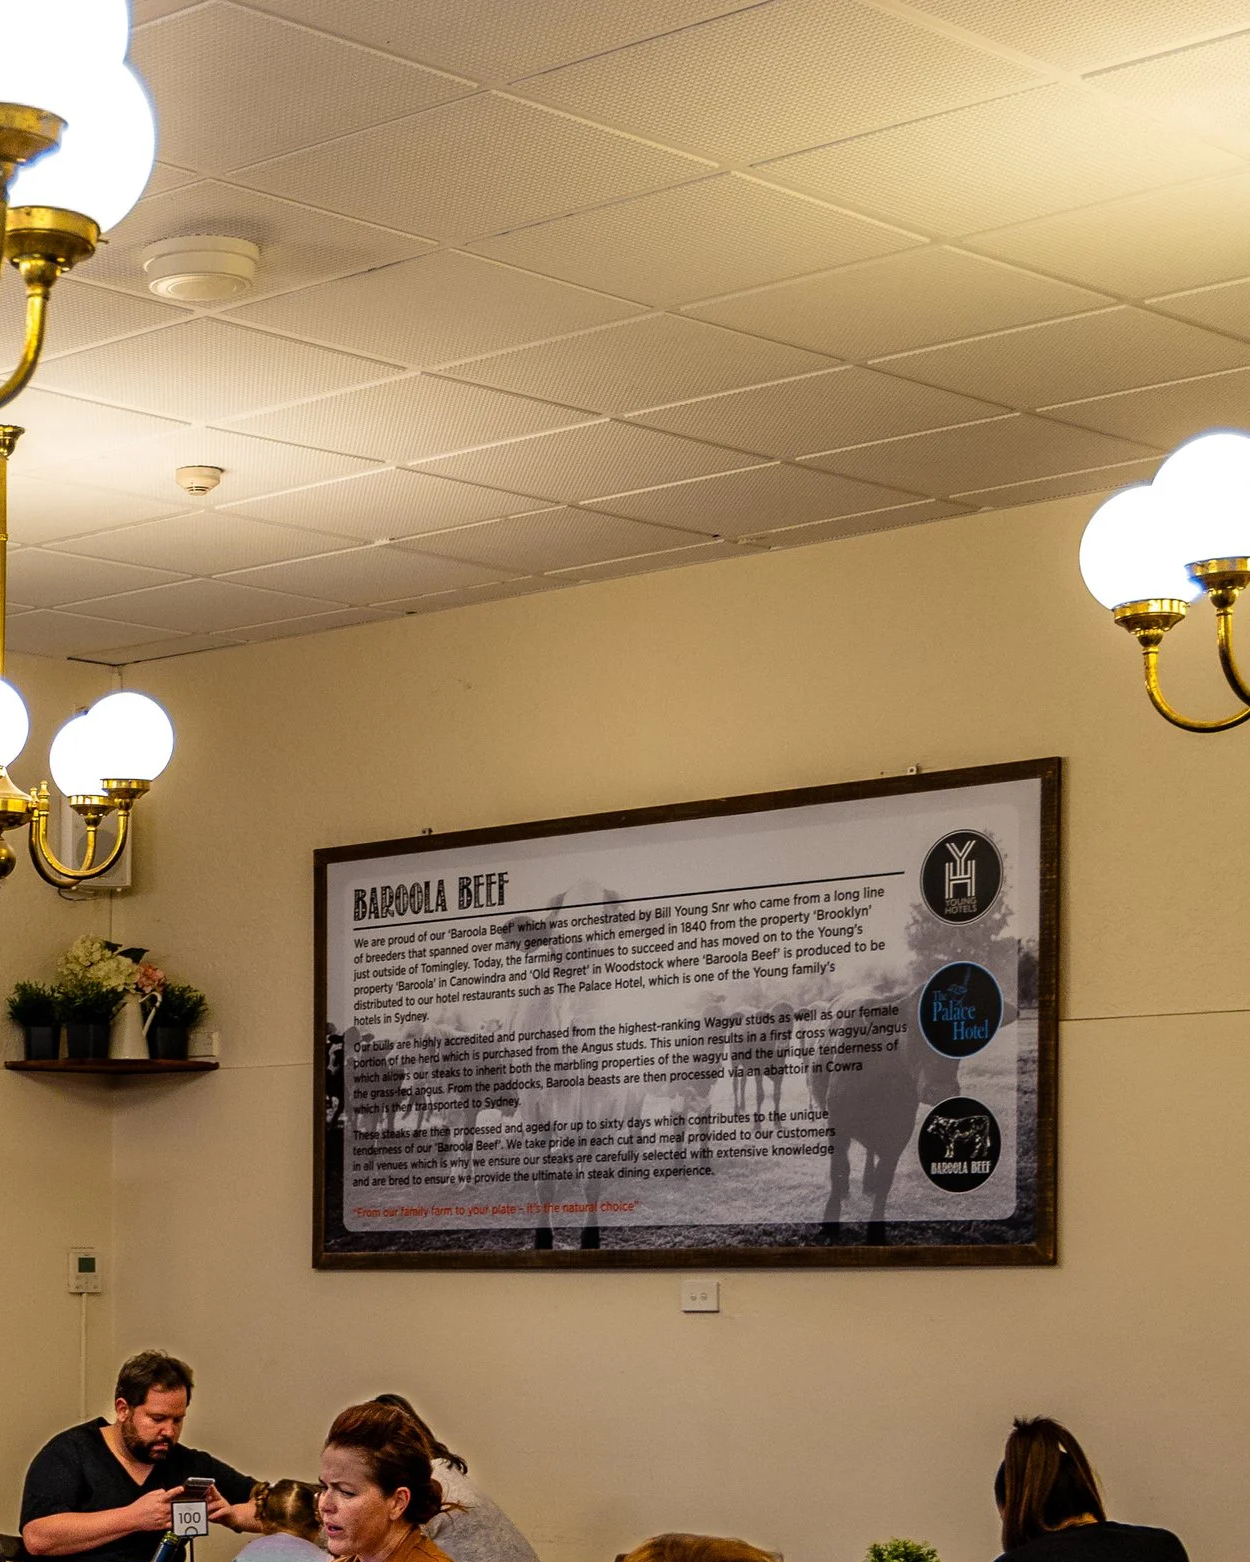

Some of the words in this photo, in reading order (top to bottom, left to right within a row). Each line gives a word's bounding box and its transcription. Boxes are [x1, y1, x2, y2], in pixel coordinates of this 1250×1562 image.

[353, 879, 448, 922] BAROOLA
[458, 871, 509, 910] BEEF
[945, 897, 977, 907] YOUNG
[354, 937, 369, 948] We
[370, 937, 386, 946] are
[387, 931, 415, 947] proud
[417, 930, 427, 942] of
[429, 931, 445, 940] our
[517, 918, 546, 932] which
[549, 919, 568, 929] was
[570, 909, 636, 926] orchestrated
[638, 907, 652, 922] by
[654, 905, 671, 918] Bill
[674, 902, 708, 919] Young
[711, 900, 730, 913] Snr
[732, 897, 757, 911] who
[759, 897, 790, 908] came
[793, 890, 820, 905] from
[823, 892, 831, 902] a
[834, 886, 860, 903] long
[863, 884, 885, 898] line
[945, 905, 977, 914] HOTELS
[353, 952, 363, 963] of
[365, 948, 406, 962] breeders
[408, 946, 427, 958] that
[429, 942, 469, 959] spanned
[471, 942, 492, 952] over
[494, 940, 521, 953] many
[524, 932, 583, 950] generations
[585, 927, 615, 942] which
[618, 923, 665, 941] emerged
[668, 923, 678, 934] in
[680, 920, 707, 933] 1840
[709, 916, 736, 930] from
[739, 914, 757, 927] the
[760, 910, 810, 928] property
[353, 968, 370, 981] just
[372, 963, 406, 977] outside
[408, 962, 418, 974] of
[420, 958, 470, 975] Tomingley.
[473, 954, 503, 971] Today,
[505, 953, 522, 965] the
[524, 949, 563, 966] farming
[565, 945, 615, 960] continues
[617, 944, 629, 955] to
[631, 939, 674, 954] succeed
[677, 936, 697, 950] and
[700, 934, 719, 948] has
[722, 931, 759, 946] moved
[762, 932, 777, 942] on
[780, 929, 793, 941] to
[795, 926, 814, 939] the
[353, 981, 393, 997] property
[438, 977, 447, 987] in
[449, 970, 506, 986] Canowindra
[508, 968, 527, 981] and
[592, 963, 601, 974] in
[604, 956, 664, 973] Woodstock
[666, 953, 699, 968] where
[783, 946, 793, 958] is
[795, 940, 851, 959] produced
[854, 940, 867, 952] to
[870, 937, 885, 950] be
[353, 995, 403, 1010] distributed
[405, 995, 415, 1006] to
[417, 996, 433, 1005] our
[435, 990, 459, 1003] hotel
[462, 987, 516, 1001] restaurants
[518, 984, 541, 996] such
[543, 986, 554, 994] as
[557, 981, 576, 993] The
[578, 978, 612, 992] Palace
[614, 975, 645, 990] Hotel,
[648, 972, 679, 986] which
[682, 972, 691, 983] is
[693, 972, 714, 982] one
[717, 968, 729, 980] of
[731, 966, 750, 979] the
[753, 964, 788, 980] Young
[353, 1012, 381, 1025] hotels
[383, 1013, 392, 1023] in
[394, 1009, 429, 1025] Sydney.
[933, 1000, 976, 1021] Palace
[444, 1031, 494, 1045] accredited
[497, 1030, 515, 1042] and
[518, 1026, 569, 1043] purchased
[571, 1024, 596, 1037] from
[598, 1022, 616, 1035] the
[618, 1016, 701, 1036] highest-ranking
[704, 1014, 744, 1030] Wagyu
[953, 1019, 989, 1040] Hotel
[482, 1045, 533, 1061] purchased
[535, 1043, 559, 1056] from
[561, 1042, 578, 1054] the
[581, 1040, 613, 1055] Angus
[616, 1037, 646, 1050] studs.
[649, 1035, 672, 1048] This
[674, 1034, 704, 1046] union
[707, 1030, 744, 1044] results
[601, 1054, 655, 1070] properties
[657, 1052, 669, 1064] of
[672, 1051, 689, 1064] the
[692, 1052, 728, 1065] wagyu
[731, 1047, 752, 1060] and
[546, 1074, 585, 1087] Baroola
[587, 1072, 621, 1085] beasts
[623, 1074, 640, 1083] are
[643, 1069, 667, 1082] then
[669, 1066, 725, 1083] processed
[484, 1094, 521, 1109] Sydney.
[586, 1119, 597, 1129] to
[599, 1117, 624, 1131] sixty
[627, 1115, 651, 1130] days
[653, 1113, 685, 1126] which
[687, 1110, 750, 1125] contributes
[753, 1111, 765, 1122] to
[768, 1108, 787, 1121] the
[616, 1134, 633, 1144] cut
[636, 1131, 656, 1144] and
[659, 1130, 684, 1143] meal
[687, 1128, 736, 1144] provided
[739, 1128, 752, 1139] to
[754, 1130, 774, 1139] our
[776, 1125, 836, 1138] customers
[595, 1149, 639, 1164] carefully
[642, 1147, 687, 1160] selected
[689, 1146, 713, 1158] with
[716, 1145, 768, 1157] extensive
[587, 1166, 615, 1178] steak
[617, 1165, 650, 1180] dining
[651, 1164, 714, 1179] experience.
[931, 1161, 968, 1175] BAROOLA
[971, 1160, 991, 1174] BEEF
[383, 1208, 398, 1216] our
[401, 1205, 427, 1218] family
[431, 1204, 452, 1215] farm
[456, 1205, 464, 1215] to
[468, 1206, 488, 1217] your
[491, 1202, 515, 1216] plate
[544, 1201, 559, 1213] the
[562, 1200, 597, 1212] natural
[179, 1512, 201, 1524] 100
